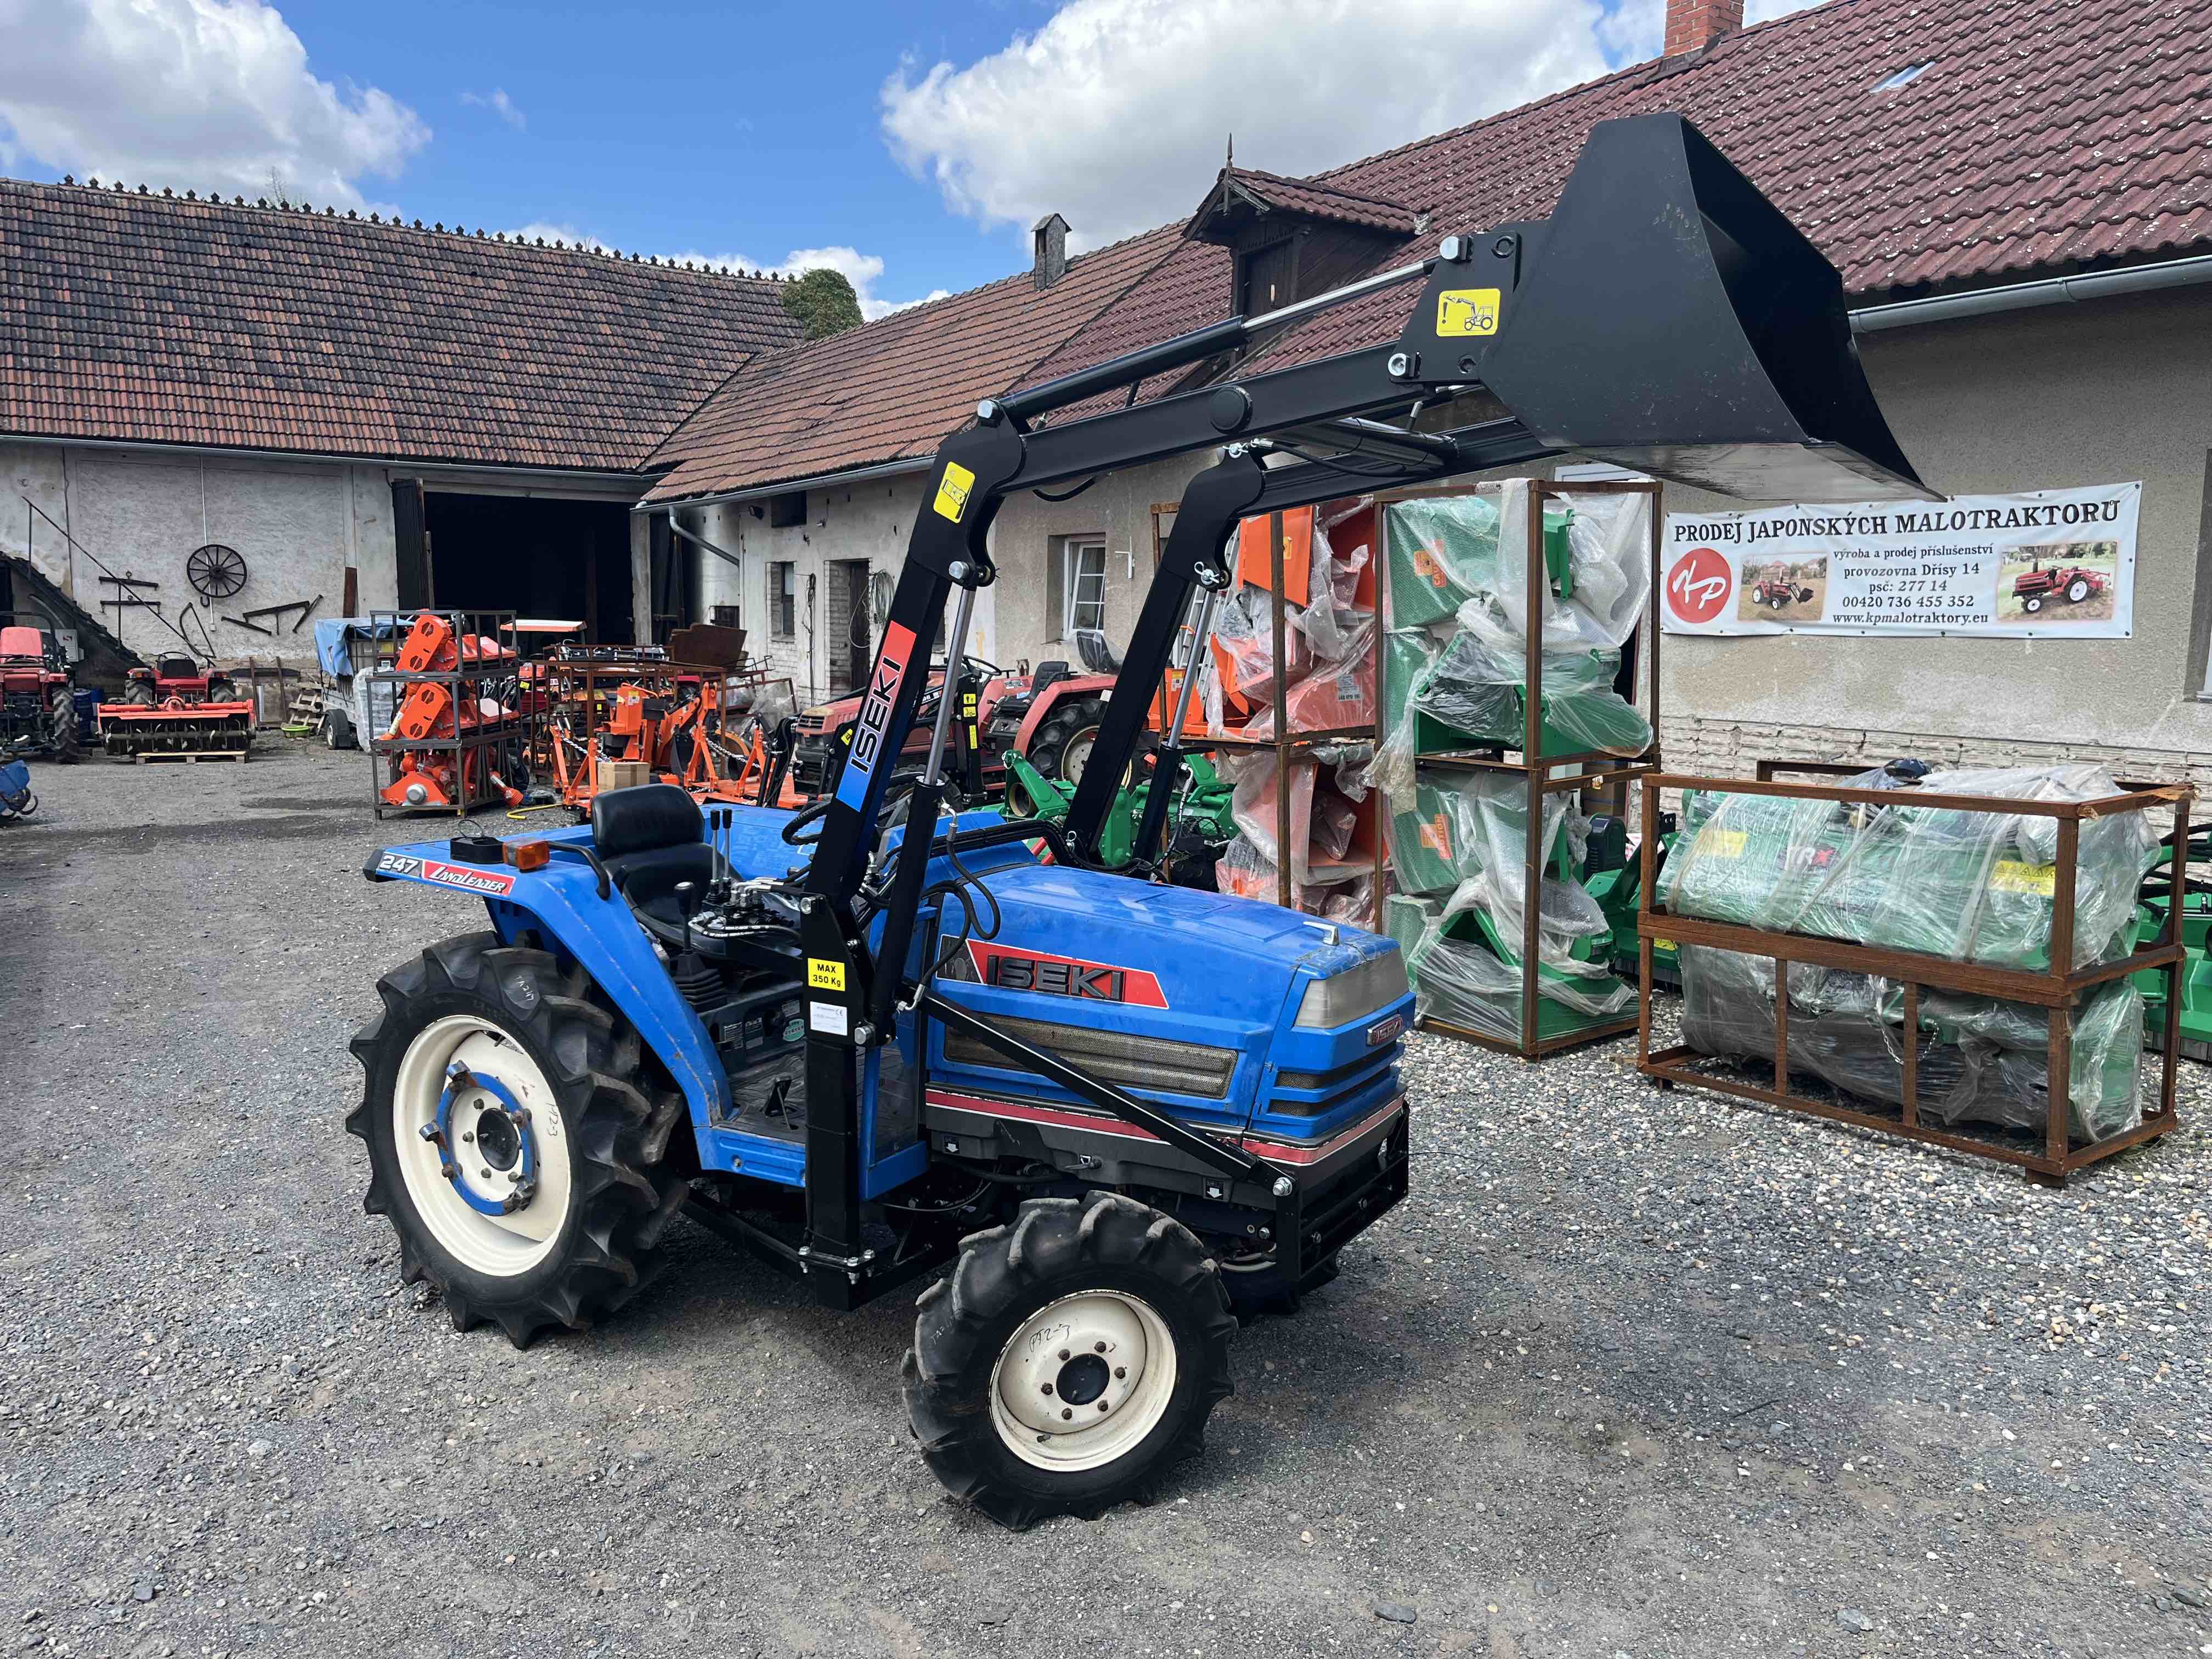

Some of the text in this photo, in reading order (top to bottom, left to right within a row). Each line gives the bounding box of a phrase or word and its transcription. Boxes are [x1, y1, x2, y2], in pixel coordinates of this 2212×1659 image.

[1674, 500, 2120, 544] PRODEJ JAPONSKÝCH MALOTRAKTORŮ
[1833, 549, 1870, 560] výroba
[1884, 547, 1916, 560] prodej
[1921, 543, 1994, 560] příslušenství
[1844, 563, 1979, 578] provozovna Dřísy 14
[1870, 580, 1947, 594] psč: 277 14
[1842, 595, 1974, 607] 00420 736 455 352
[1833, 612, 1988, 625] www.kpmalotraktory.eu
[850, 656, 902, 775] ISEKI
[379, 855, 419, 873] 247
[817, 964, 836, 973] MAX
[813, 974, 841, 988] 350 Kg
[988, 955, 1126, 1002] ISEKI
